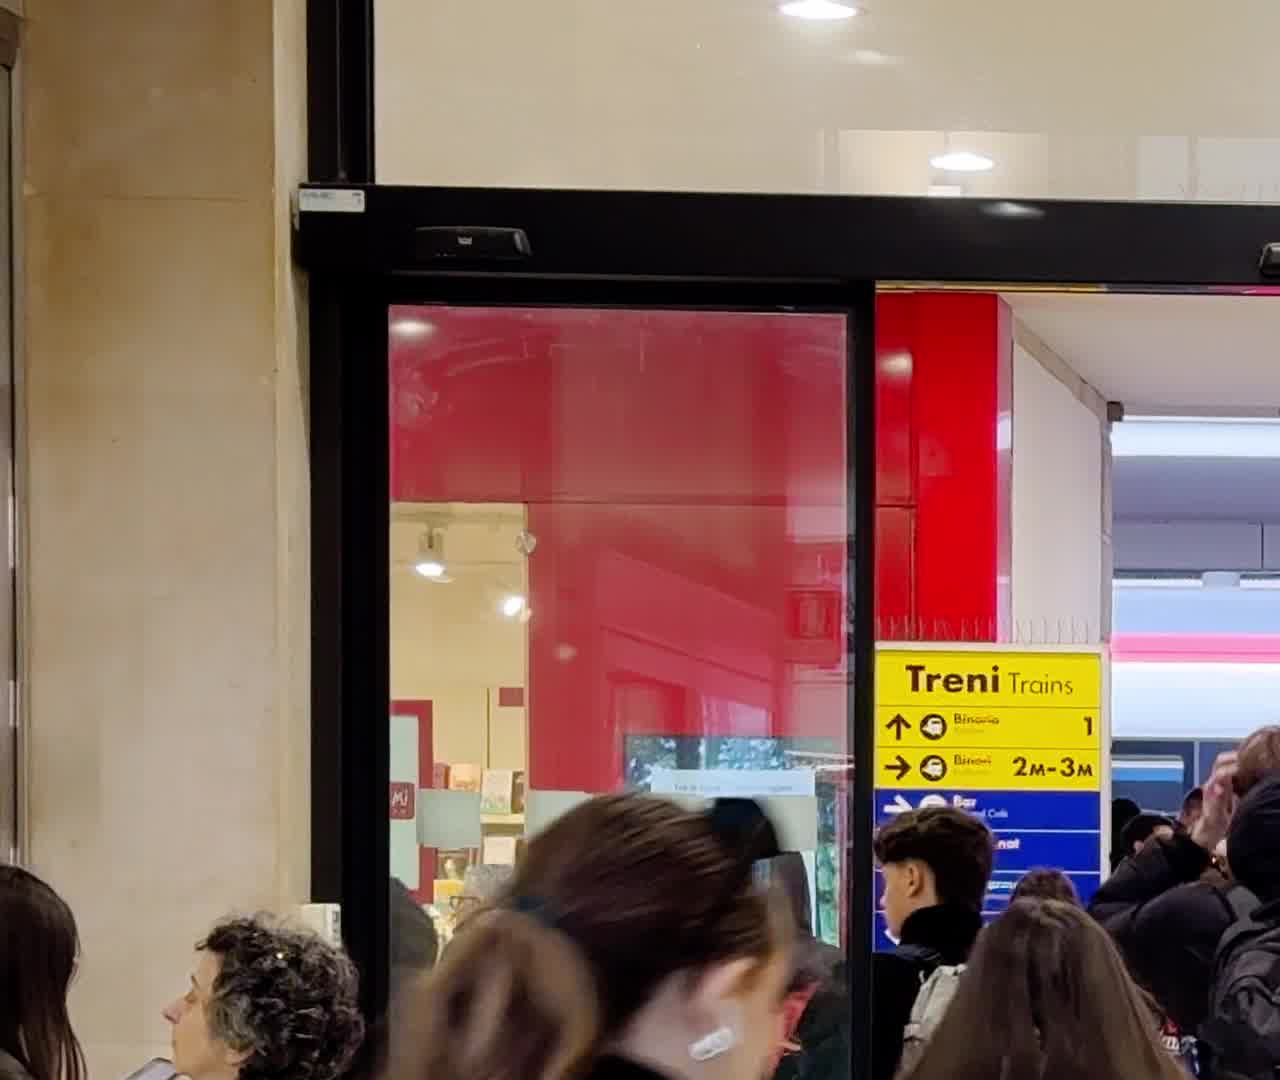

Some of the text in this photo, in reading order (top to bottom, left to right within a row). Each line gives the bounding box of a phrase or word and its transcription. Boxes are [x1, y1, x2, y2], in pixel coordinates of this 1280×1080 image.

[904, 664, 1074, 695] Treni Trains
[953, 712, 1093, 736] Binario 1
